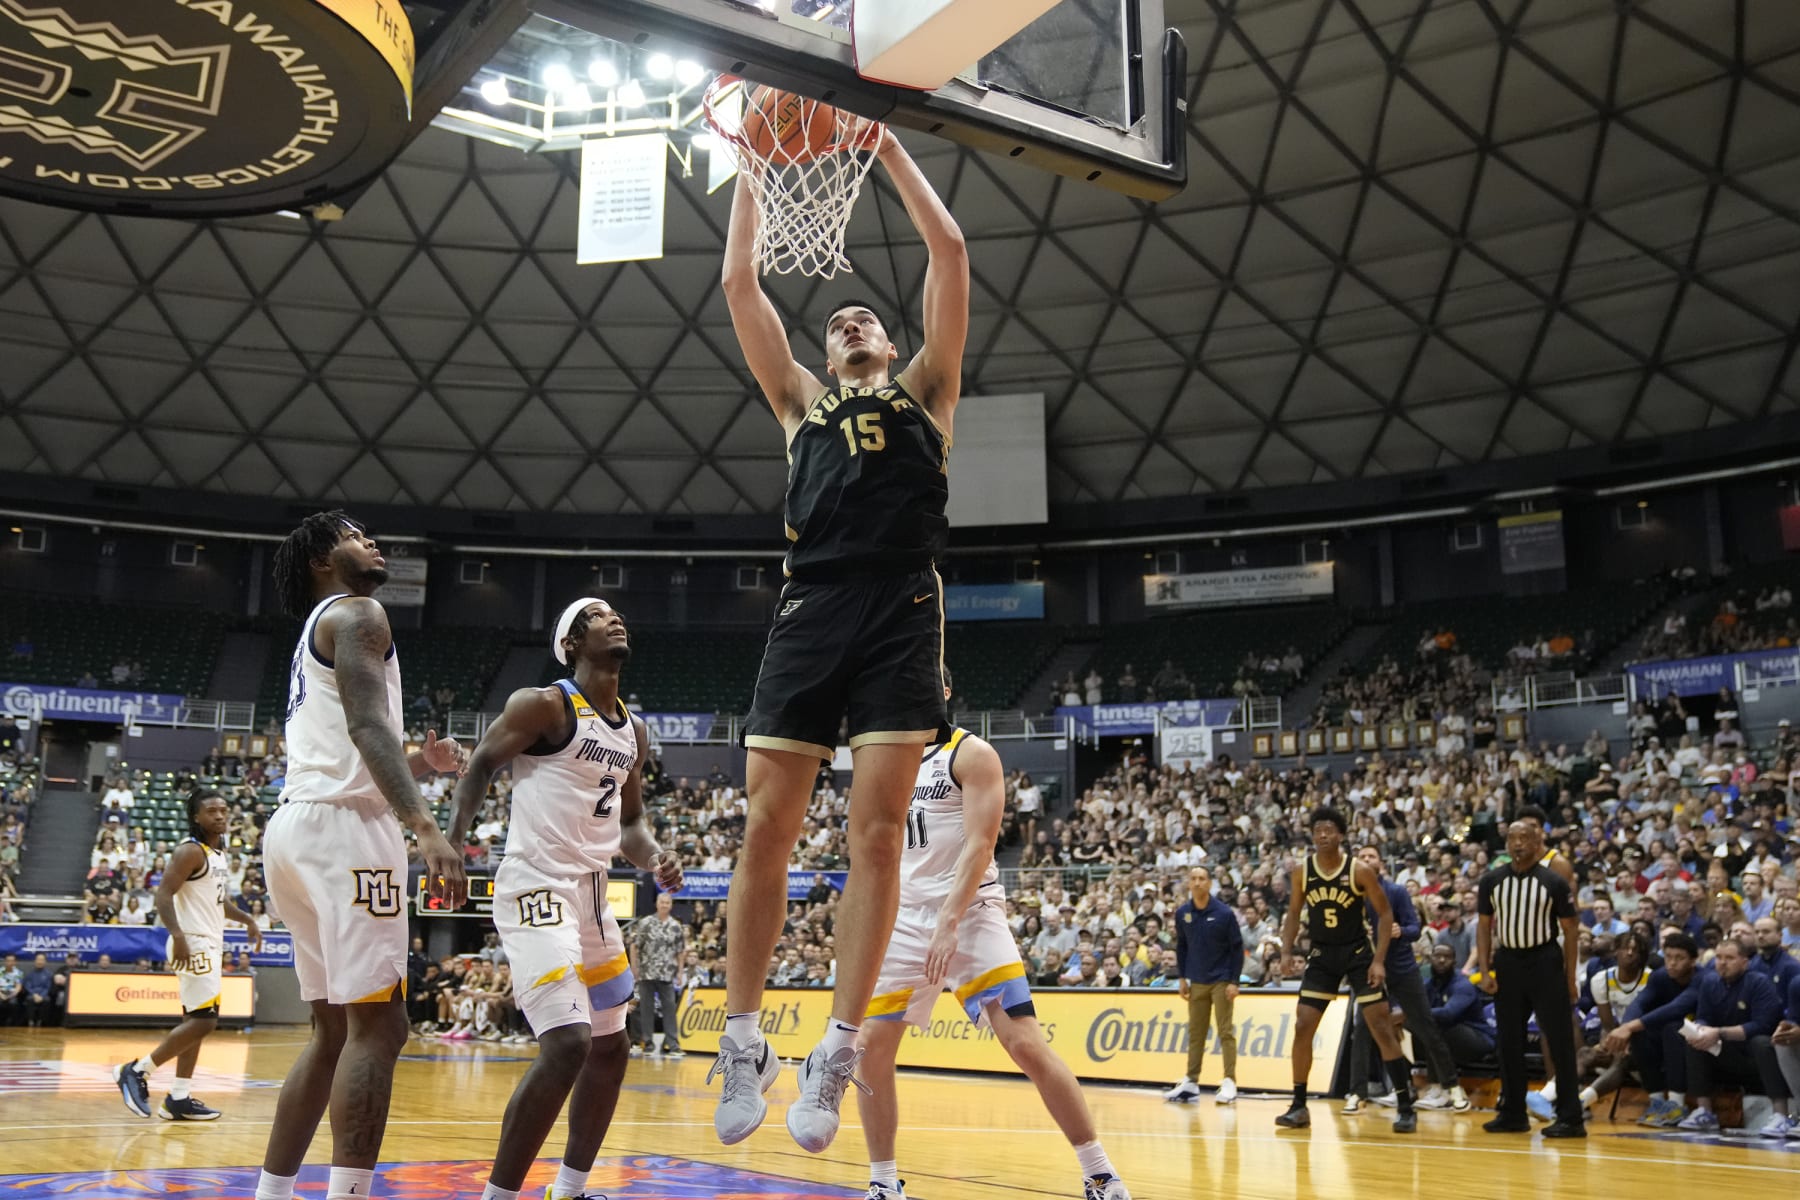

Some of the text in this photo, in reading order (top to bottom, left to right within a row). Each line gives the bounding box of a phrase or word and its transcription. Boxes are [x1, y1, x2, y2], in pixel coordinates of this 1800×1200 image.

[374, 0, 400, 48] THE
[36, 0, 339, 190] AWAIIATHLETICS.COM
[807, 386, 914, 427] PURDUE
[839, 412, 886, 457] 15
[971, 595, 1019, 611] Energy
[1645, 663, 1723, 682] HAWAIIAN
[4, 686, 143, 715] Continental
[1093, 703, 1157, 722] hmsa
[645, 716, 698, 738] ADE
[1171, 733, 1204, 753] 25
[592, 775, 616, 818] 2
[907, 808, 928, 849] 11
[351, 869, 401, 918] MU
[516, 889, 562, 928] MU
[1306, 887, 1355, 909] PURDUE
[1324, 908, 1338, 928] 5
[222, 940, 290, 954] erprise
[115, 986, 179, 1002] Continen
[680, 1000, 787, 1039] Contital
[1086, 1008, 1291, 1063] Contintal
